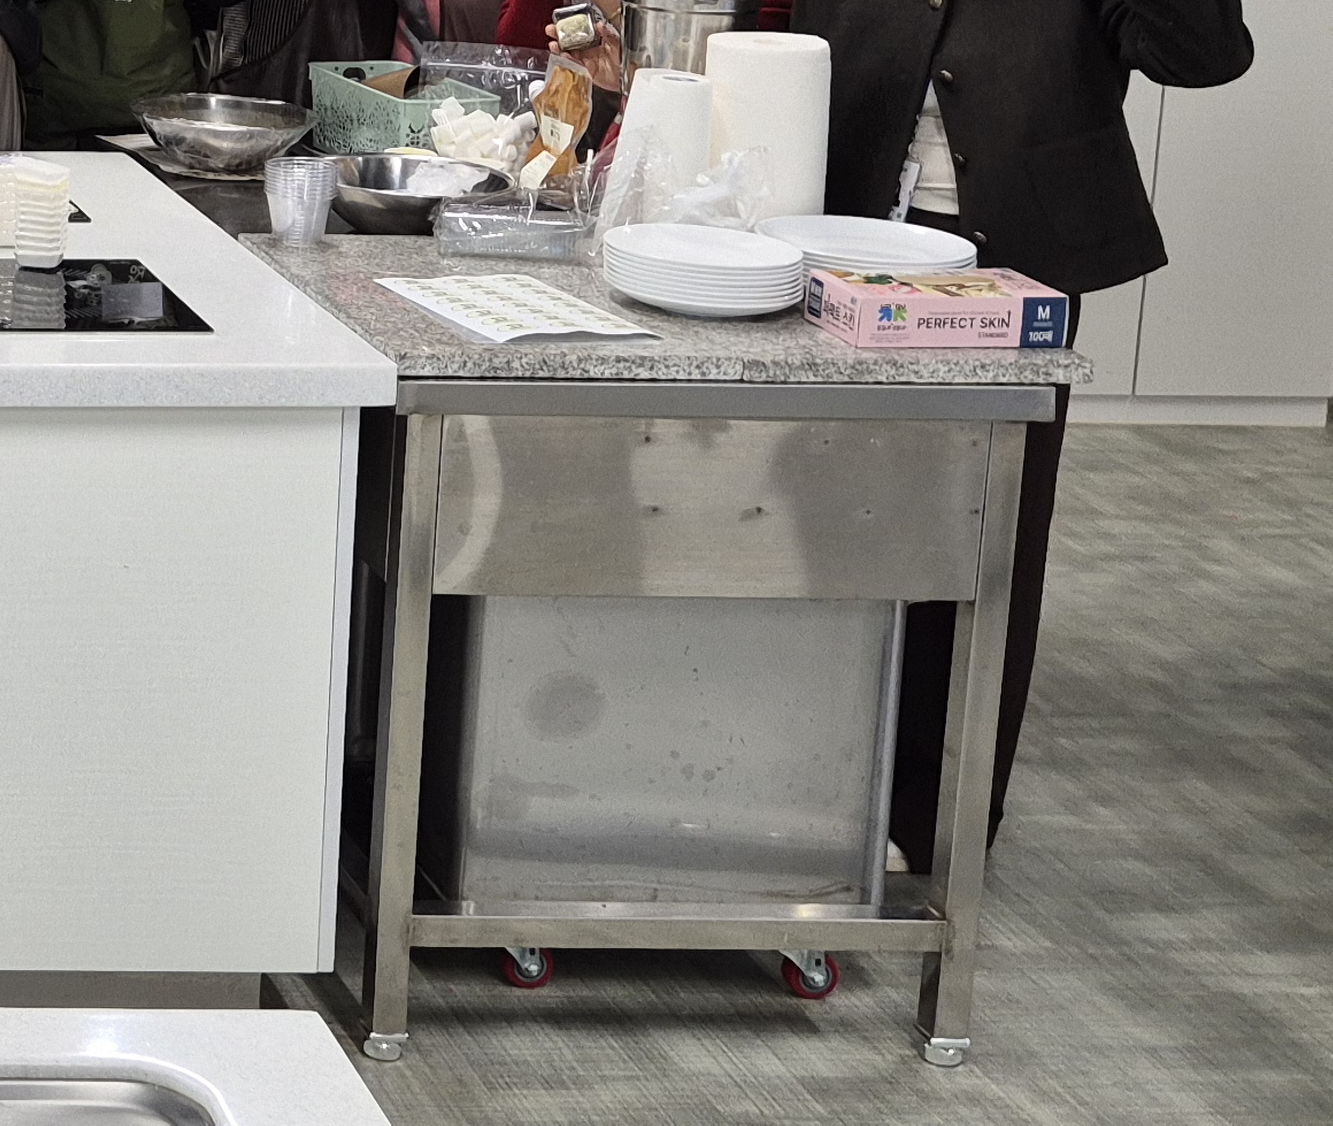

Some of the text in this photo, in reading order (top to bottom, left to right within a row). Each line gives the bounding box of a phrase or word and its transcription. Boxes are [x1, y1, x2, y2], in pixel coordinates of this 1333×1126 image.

[917, 316, 977, 330] PERFECT
[979, 309, 1012, 329] SKIN
[1037, 304, 1051, 321] M
